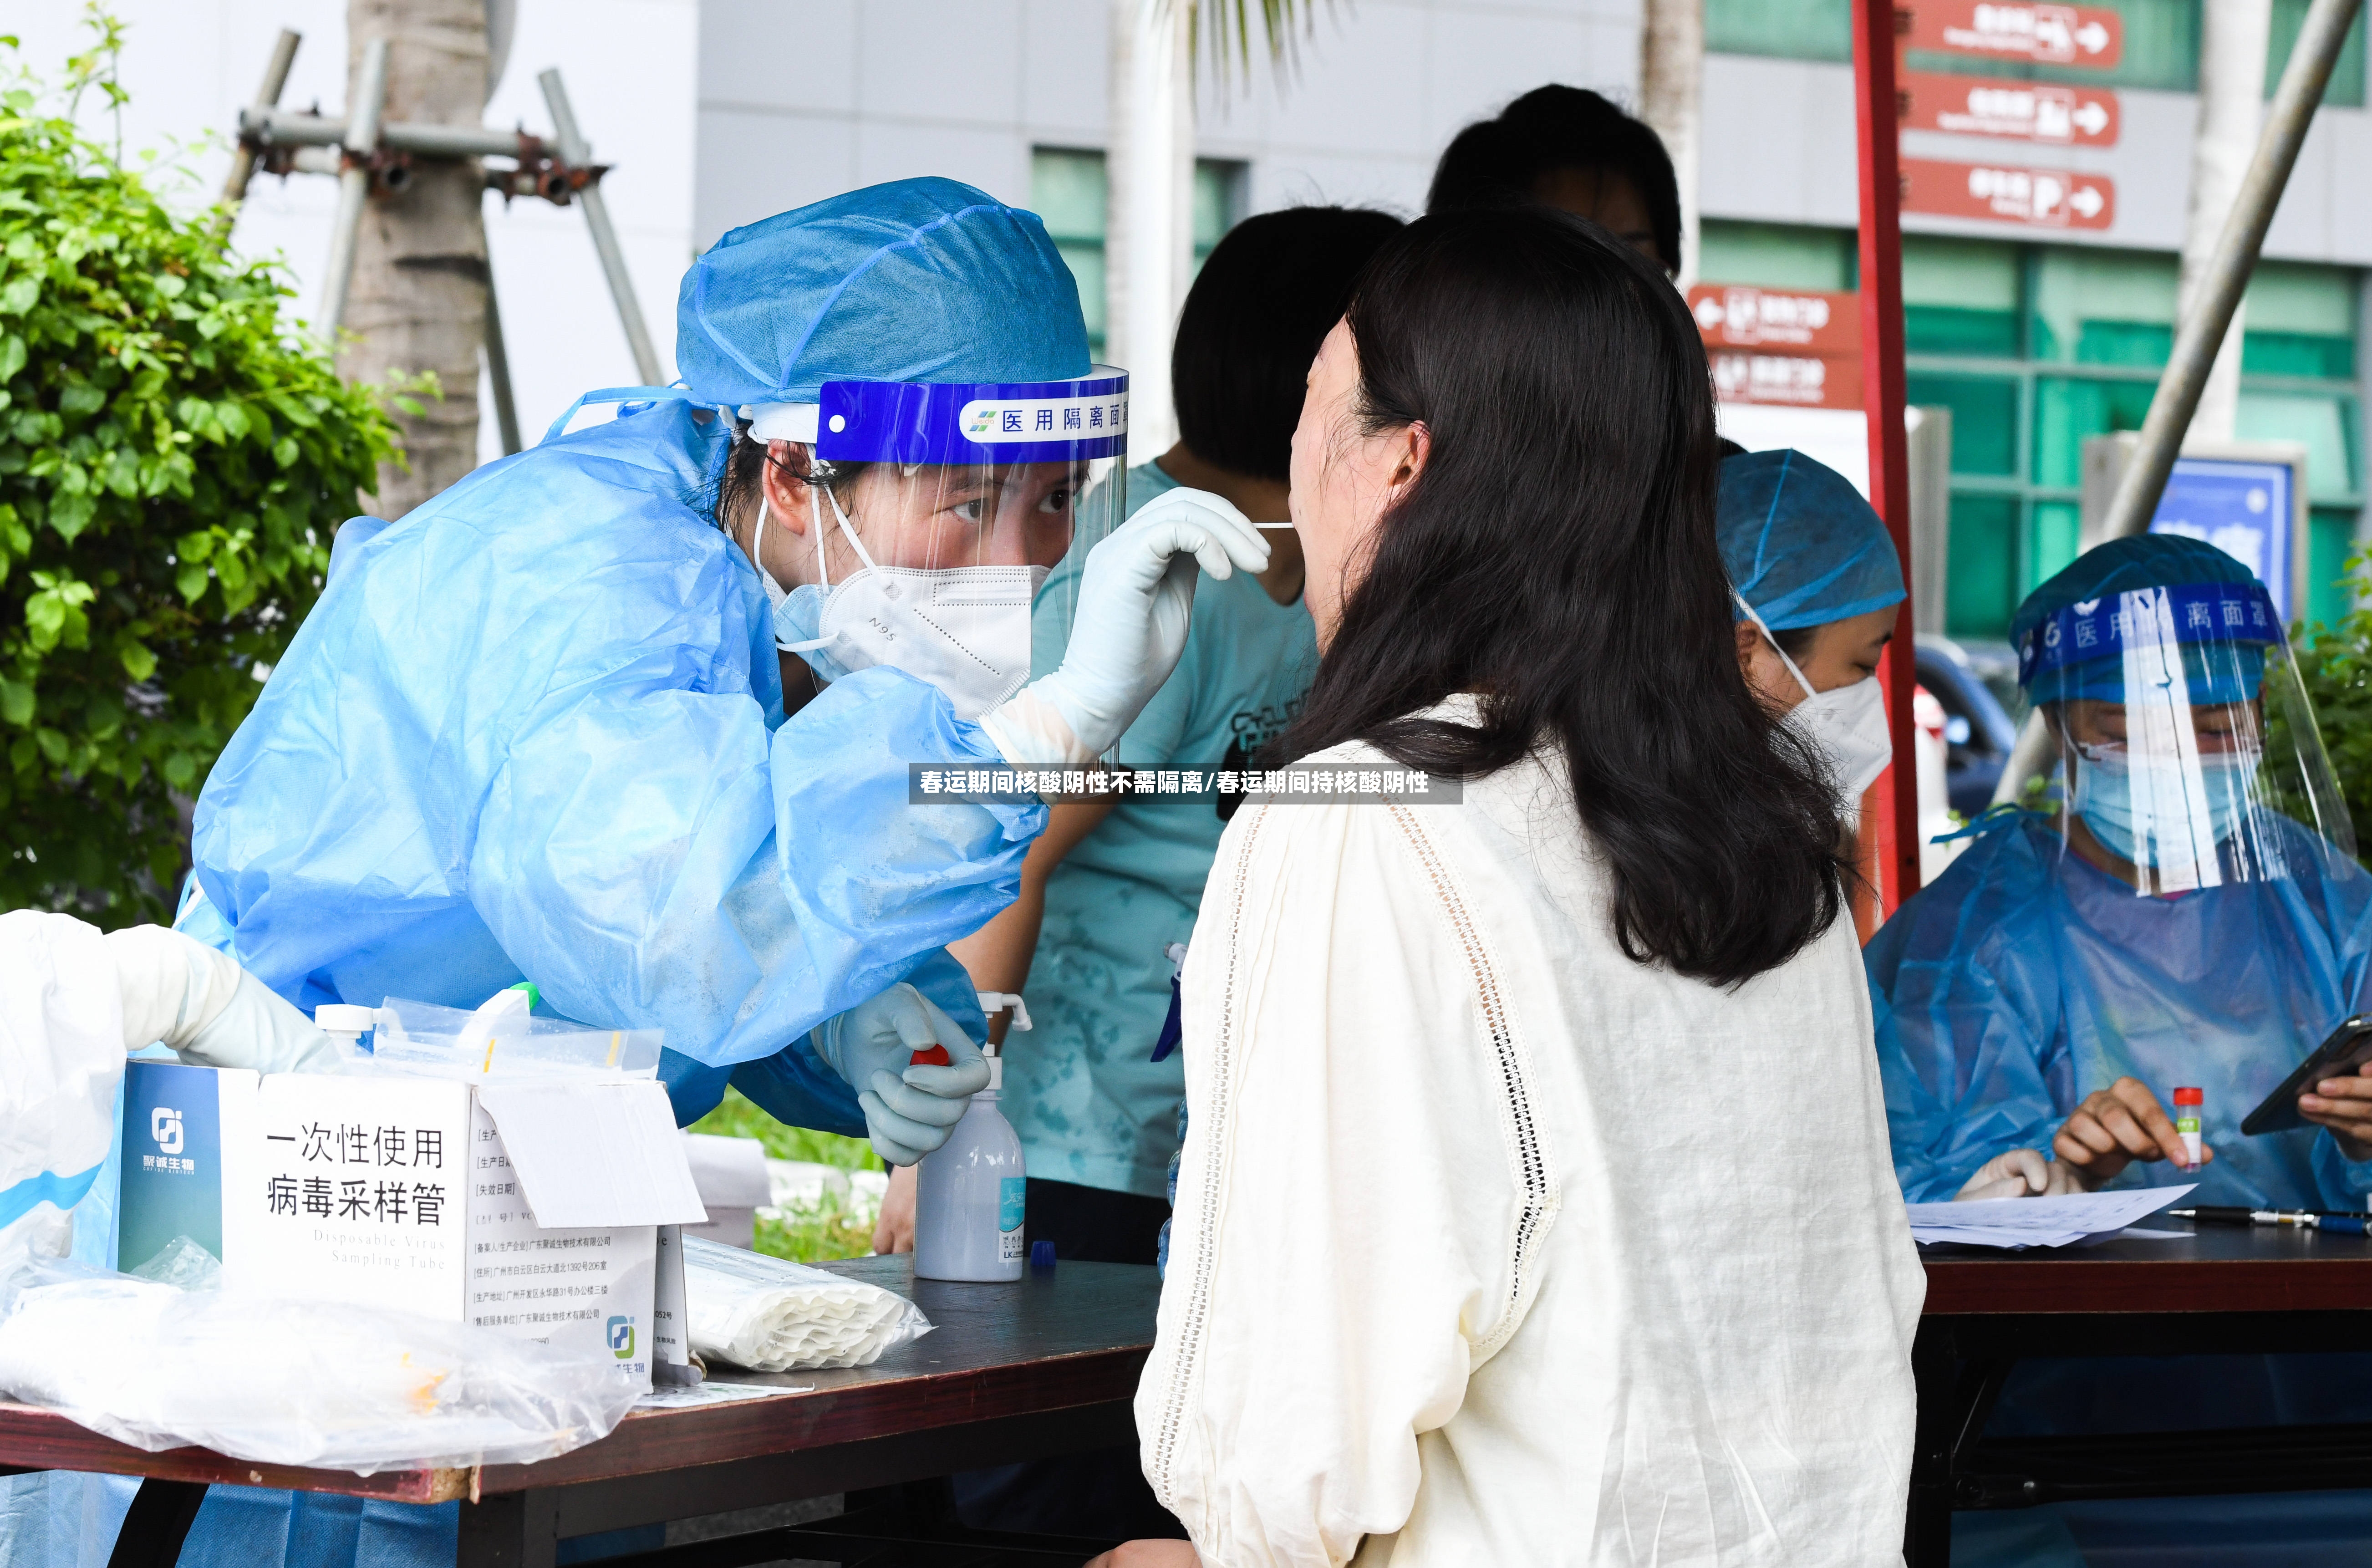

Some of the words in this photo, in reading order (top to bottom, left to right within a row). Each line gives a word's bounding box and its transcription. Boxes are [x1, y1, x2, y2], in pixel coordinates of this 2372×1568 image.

[868, 616, 896, 642] N95
[2074, 600, 2268, 648] 医用离面罩
[267, 1122, 442, 1168] 一次性使用
[143, 1155, 194, 1171] 聚诚生物
[268, 1173, 445, 1226] 病毒采样管
[314, 1229, 396, 1246] Disposable
[405, 1236, 444, 1249] Virus
[332, 1250, 400, 1269] Sampling
[409, 1255, 444, 1269] Tube
